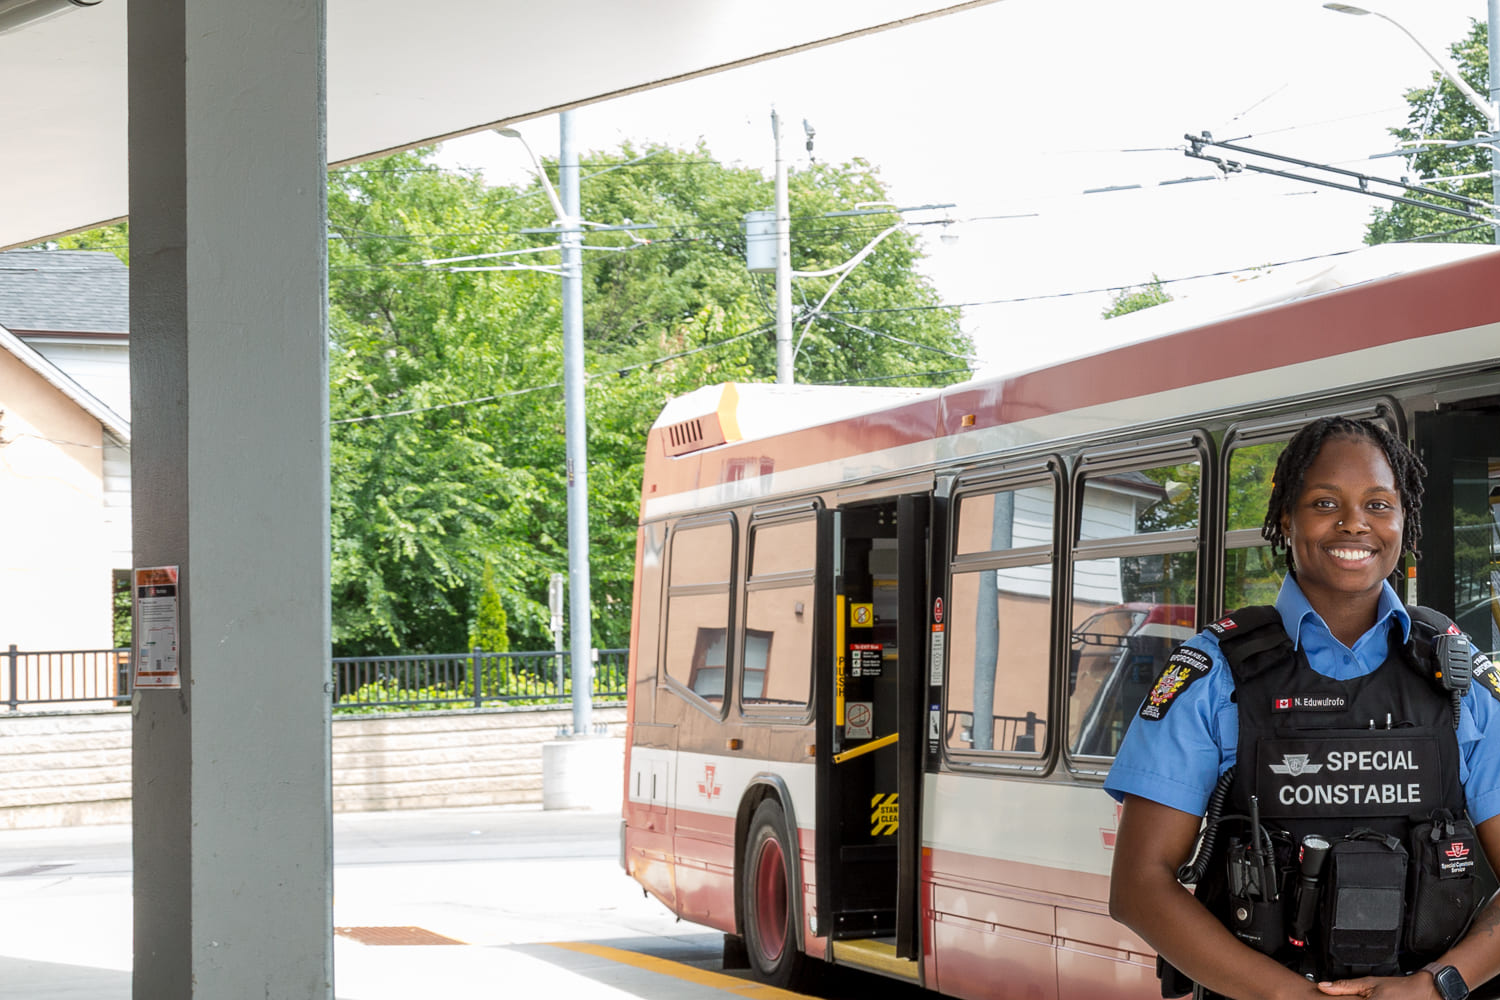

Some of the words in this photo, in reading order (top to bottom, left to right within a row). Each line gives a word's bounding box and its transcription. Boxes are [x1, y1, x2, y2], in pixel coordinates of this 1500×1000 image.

[1294, 697, 1302, 706] N.
[1326, 750, 1419, 771] SPECIAL
[1279, 783, 1421, 805] CONSTABLE
[880, 806, 898, 814] STAN
[881, 815, 898, 823] CLEA
